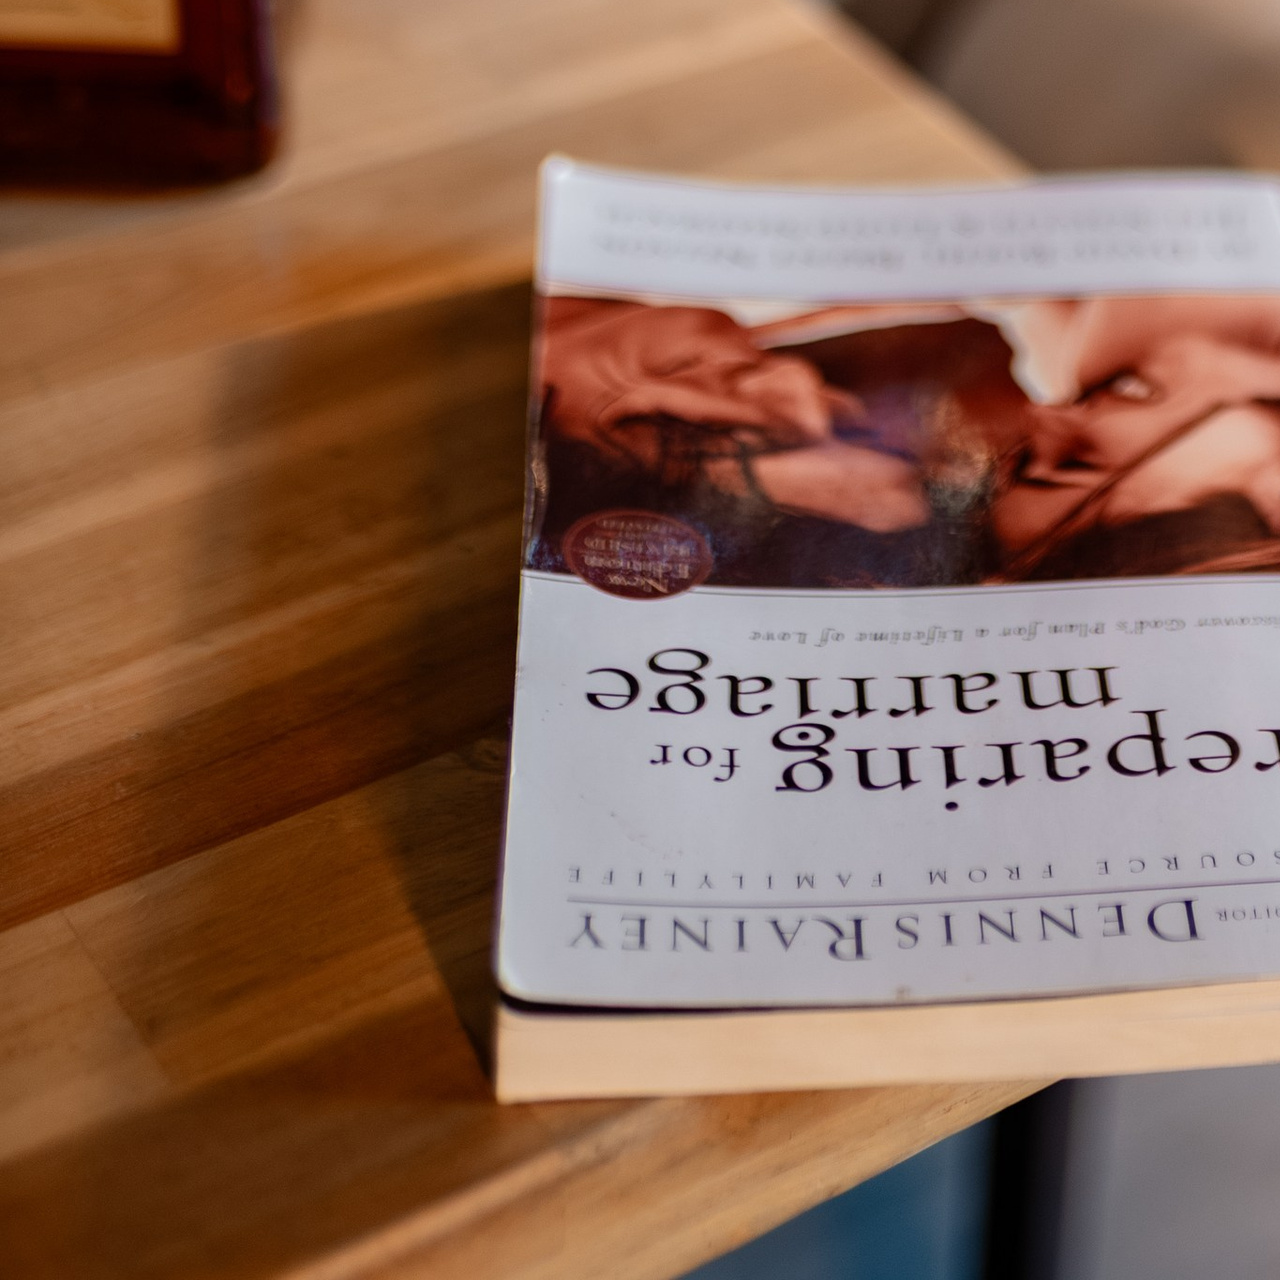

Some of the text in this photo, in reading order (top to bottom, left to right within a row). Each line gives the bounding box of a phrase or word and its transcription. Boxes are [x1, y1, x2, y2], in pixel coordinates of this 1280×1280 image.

[747, 630, 808, 646] Love
[813, 627, 845, 648] of
[854, 625, 964, 647] Lifetime
[974, 627, 990, 638] a
[998, 621, 1043, 642] for
[1047, 621, 1106, 638] Plan
[1115, 618, 1186, 636] God's
[584, 646, 1123, 743] marriage
[647, 742, 742, 784] for
[566, 865, 884, 891] FAMILYLIFE
[926, 862, 1055, 887] FROM
[893, 896, 1205, 951] DENNIS
[566, 910, 872, 963] RAINEY
